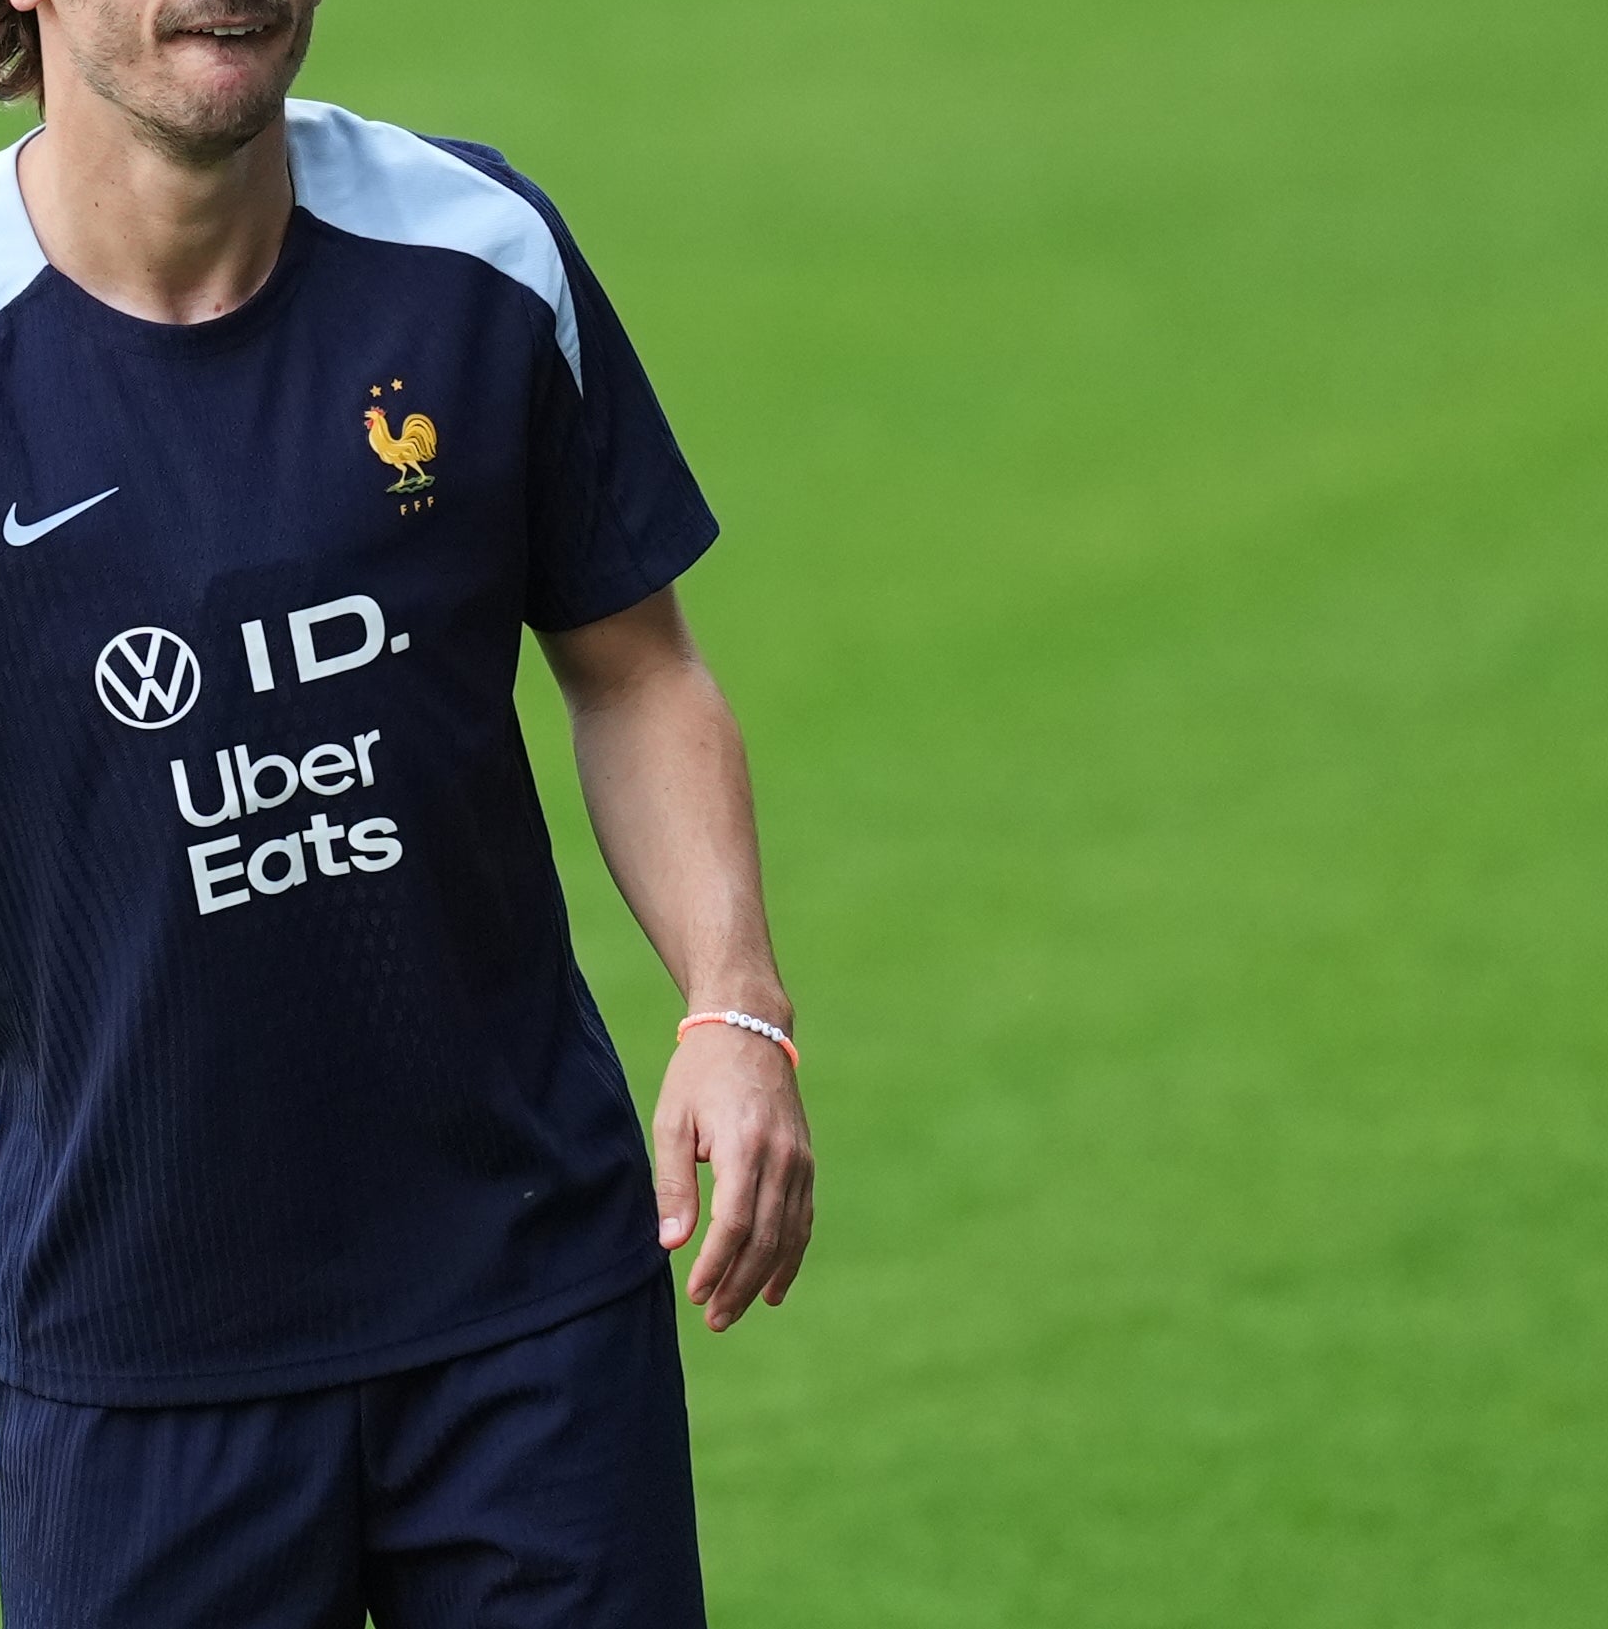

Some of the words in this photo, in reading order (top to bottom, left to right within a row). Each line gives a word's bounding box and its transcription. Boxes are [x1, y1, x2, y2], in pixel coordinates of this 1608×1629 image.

[241, 595, 410, 693] ID.
[170, 729, 381, 828] Uber
[187, 813, 404, 916] Eats
